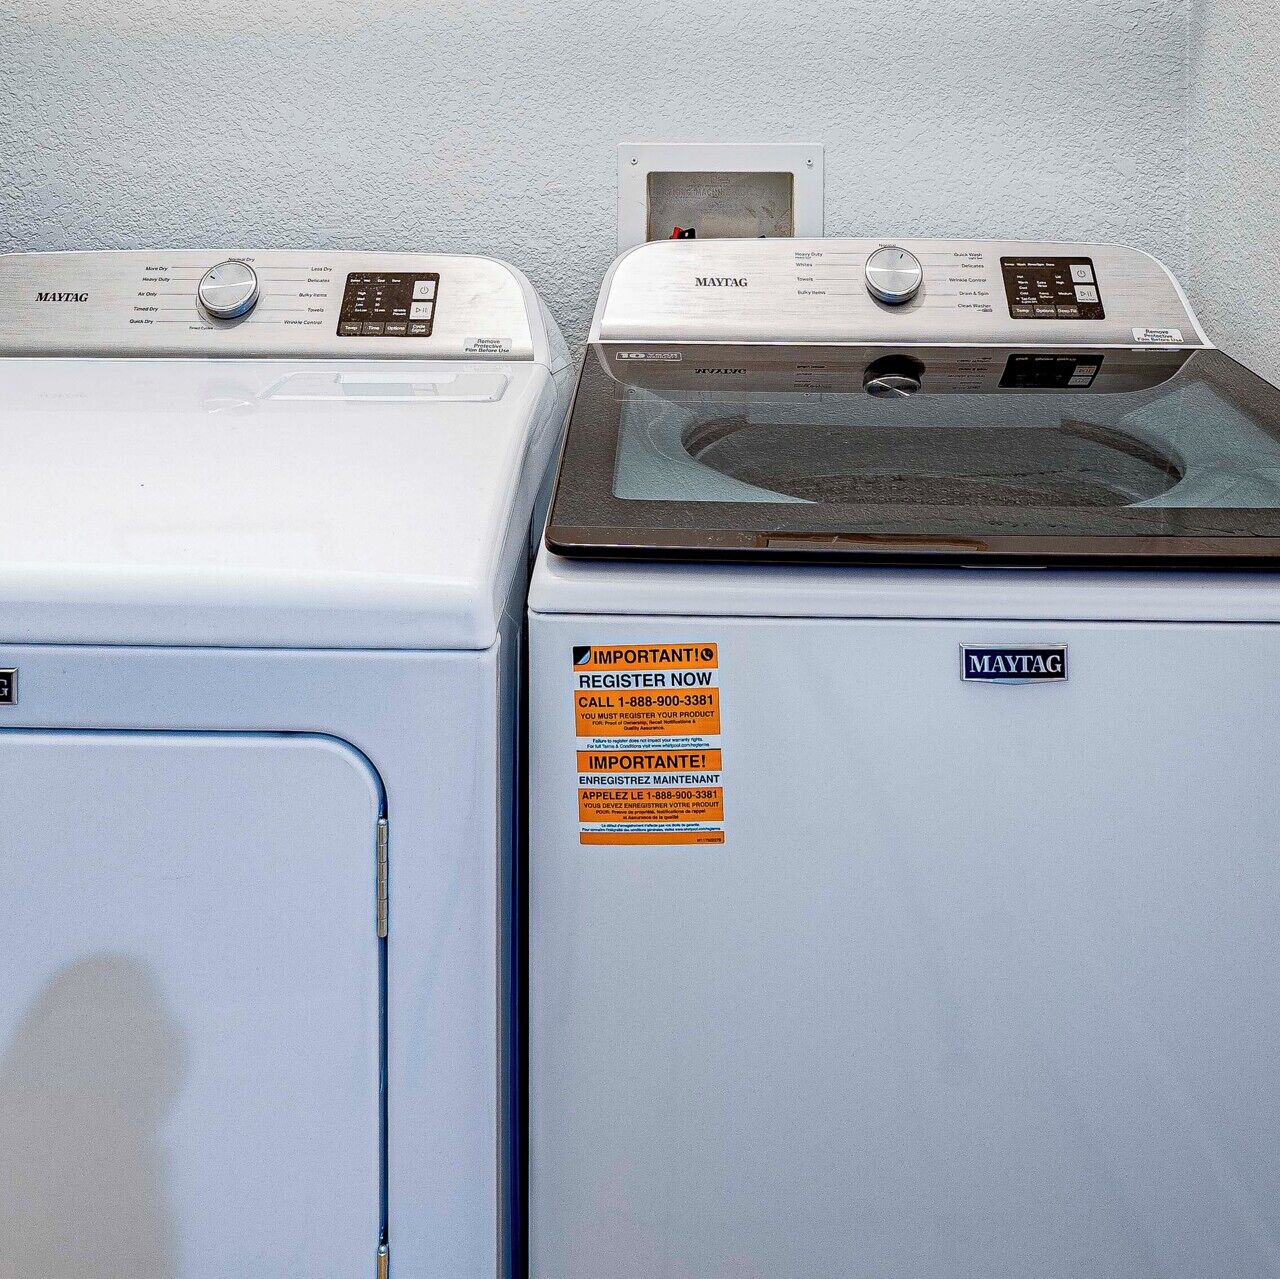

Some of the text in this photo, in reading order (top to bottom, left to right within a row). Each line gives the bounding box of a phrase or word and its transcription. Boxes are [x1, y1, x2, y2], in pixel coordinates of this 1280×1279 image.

[695, 278, 748, 287] MAYTAG
[35, 293, 88, 302] MAYTAG
[593, 648, 699, 664] IMPORTANT!
[969, 655, 1062, 673] MAYTAG
[579, 672, 712, 688] REGISTER NOW
[578, 695, 713, 707] CALL 1-888-900-3381
[589, 754, 706, 769] IMPORTANTE!
[580, 775, 720, 785] ENREGISTREZ MAINTENANT
[582, 790, 717, 800] APPELEZ LE 1-888-900-3381
